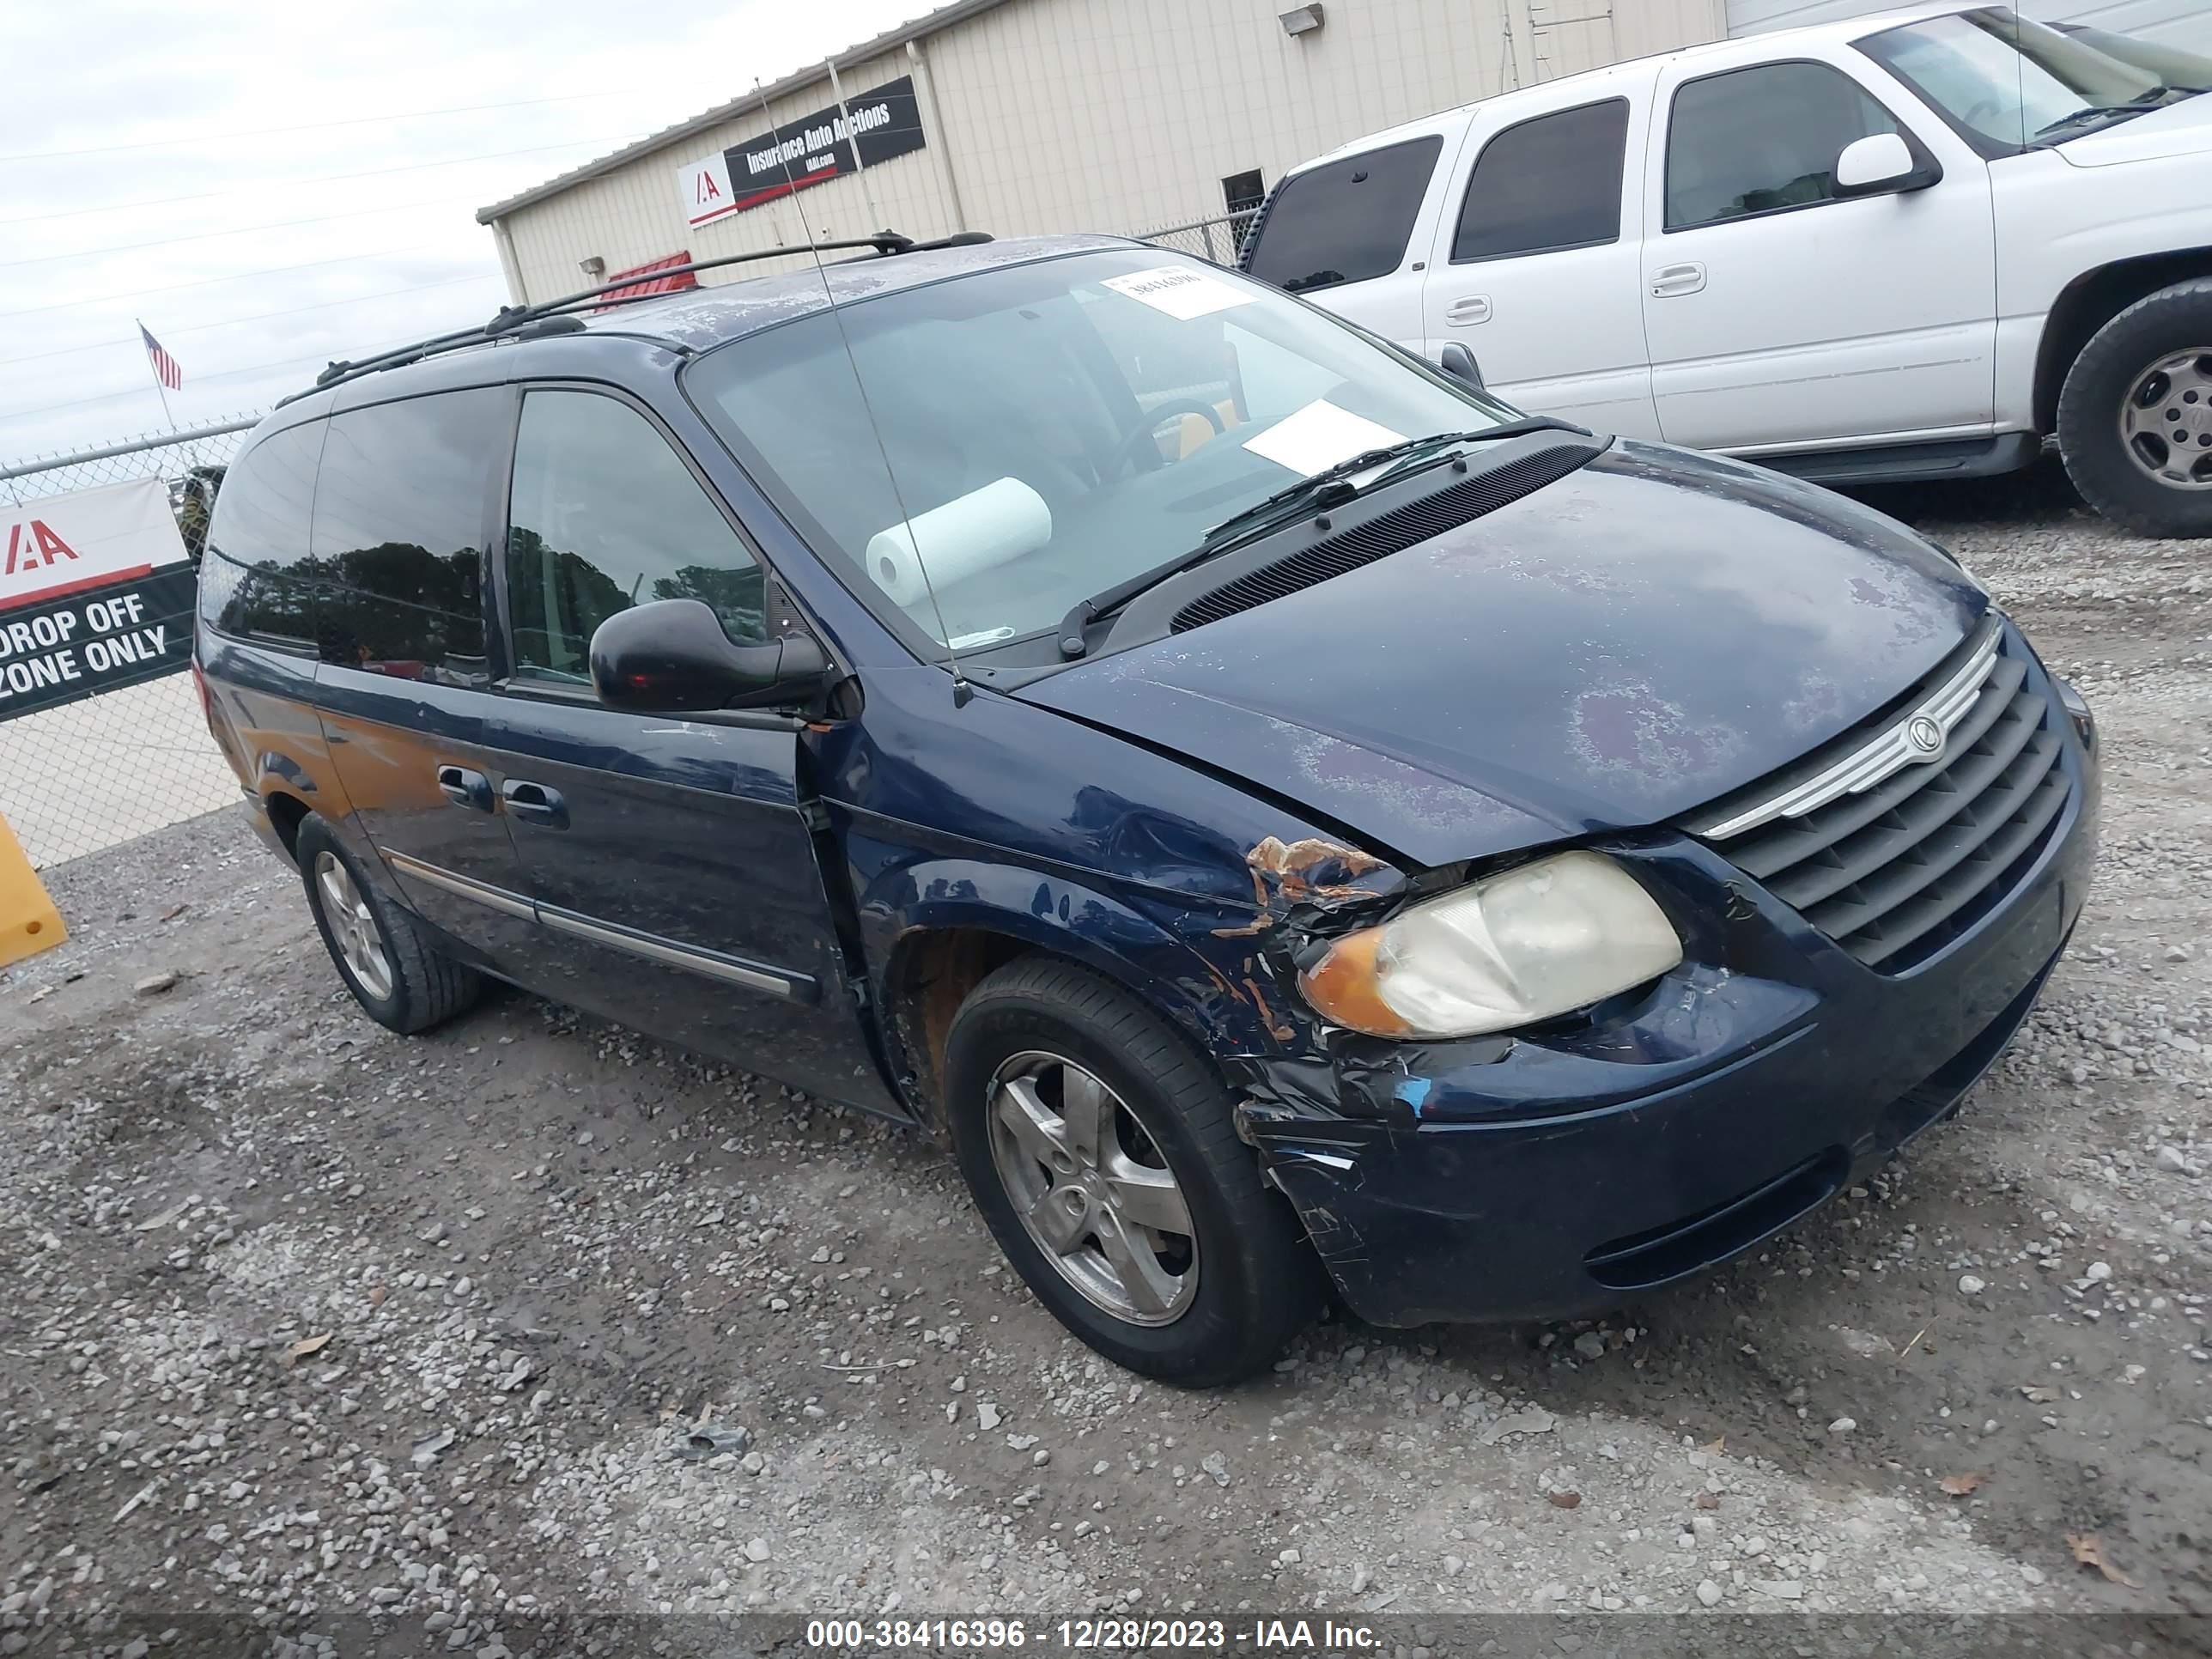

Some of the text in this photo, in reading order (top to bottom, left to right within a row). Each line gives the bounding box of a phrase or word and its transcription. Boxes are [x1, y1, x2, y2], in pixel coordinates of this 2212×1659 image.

[746, 136, 805, 175] Insurance
[805, 125, 834, 153] Auto
[85, 592, 144, 633] OFF
[84, 625, 167, 672] ONLY
